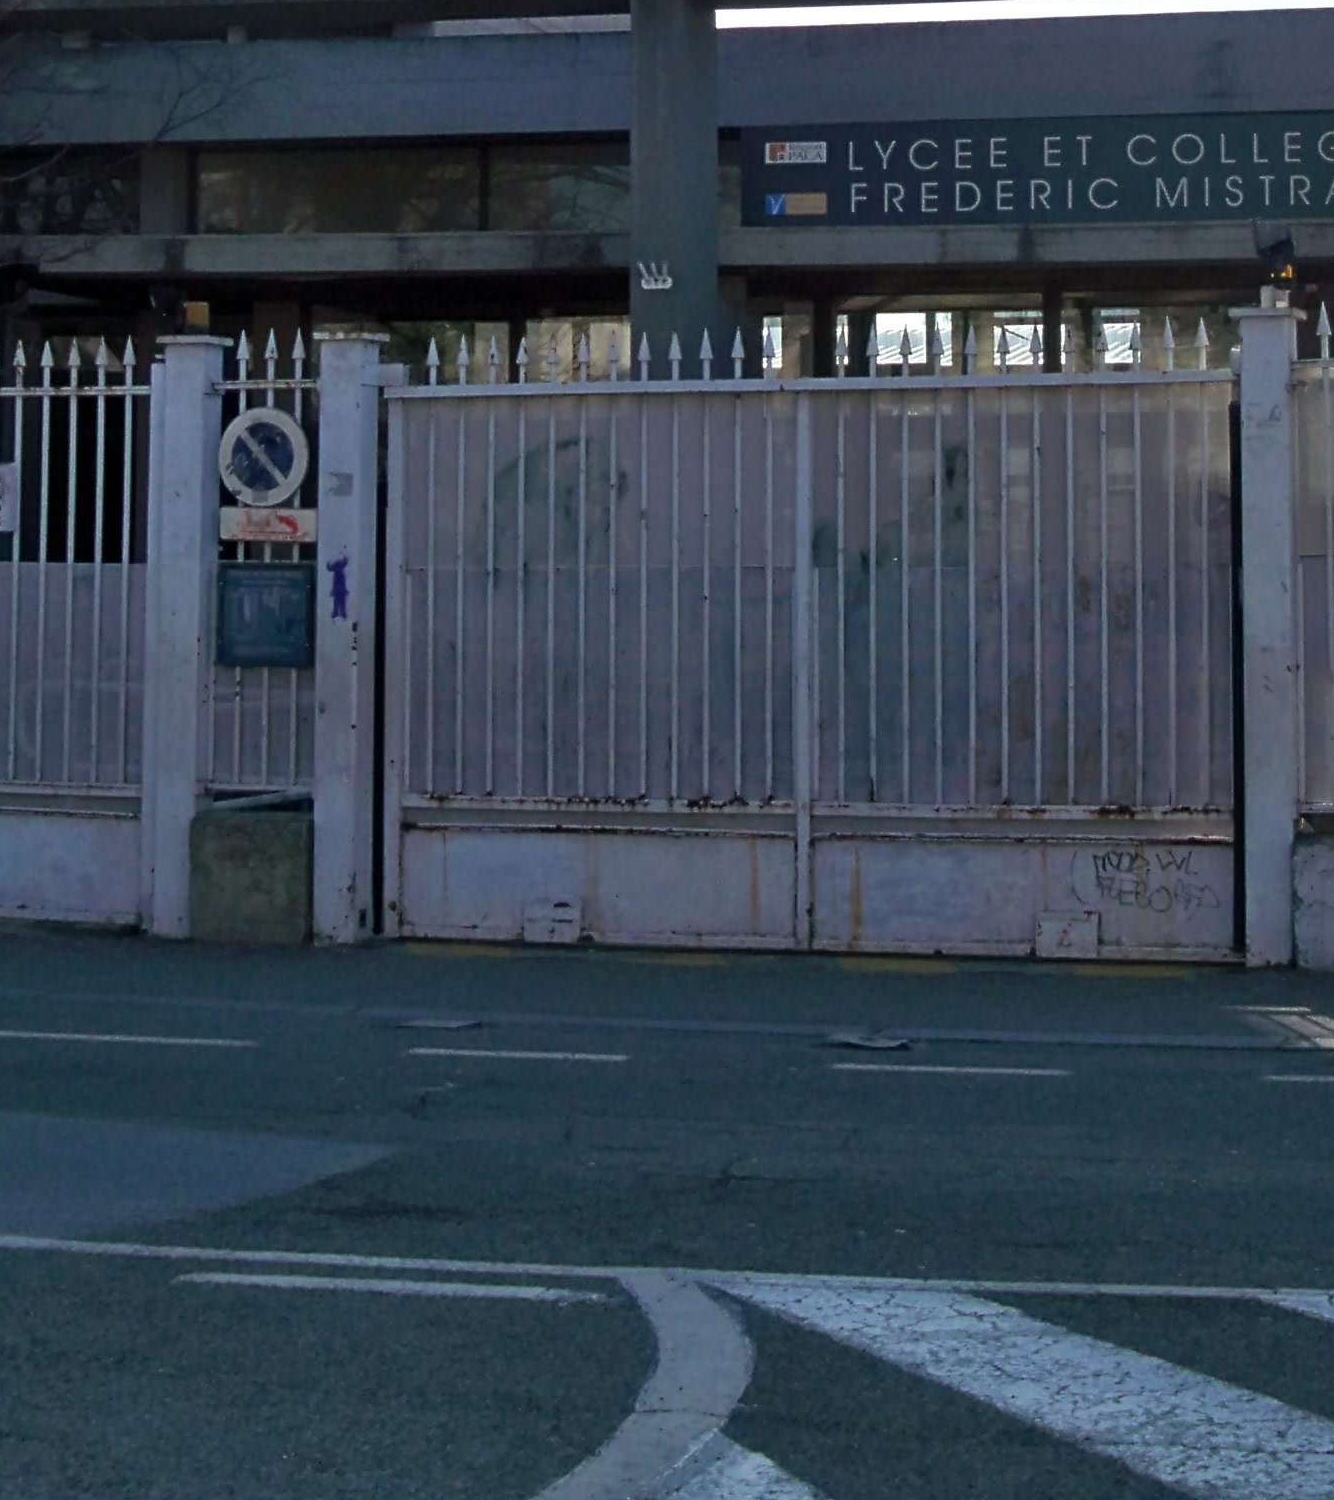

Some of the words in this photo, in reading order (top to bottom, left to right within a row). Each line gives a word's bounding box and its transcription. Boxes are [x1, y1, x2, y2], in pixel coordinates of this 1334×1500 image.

[848, 137, 1008, 172] LYCEE
[1042, 135, 1093, 167] ET
[850, 177, 1119, 213] FREDERIC
